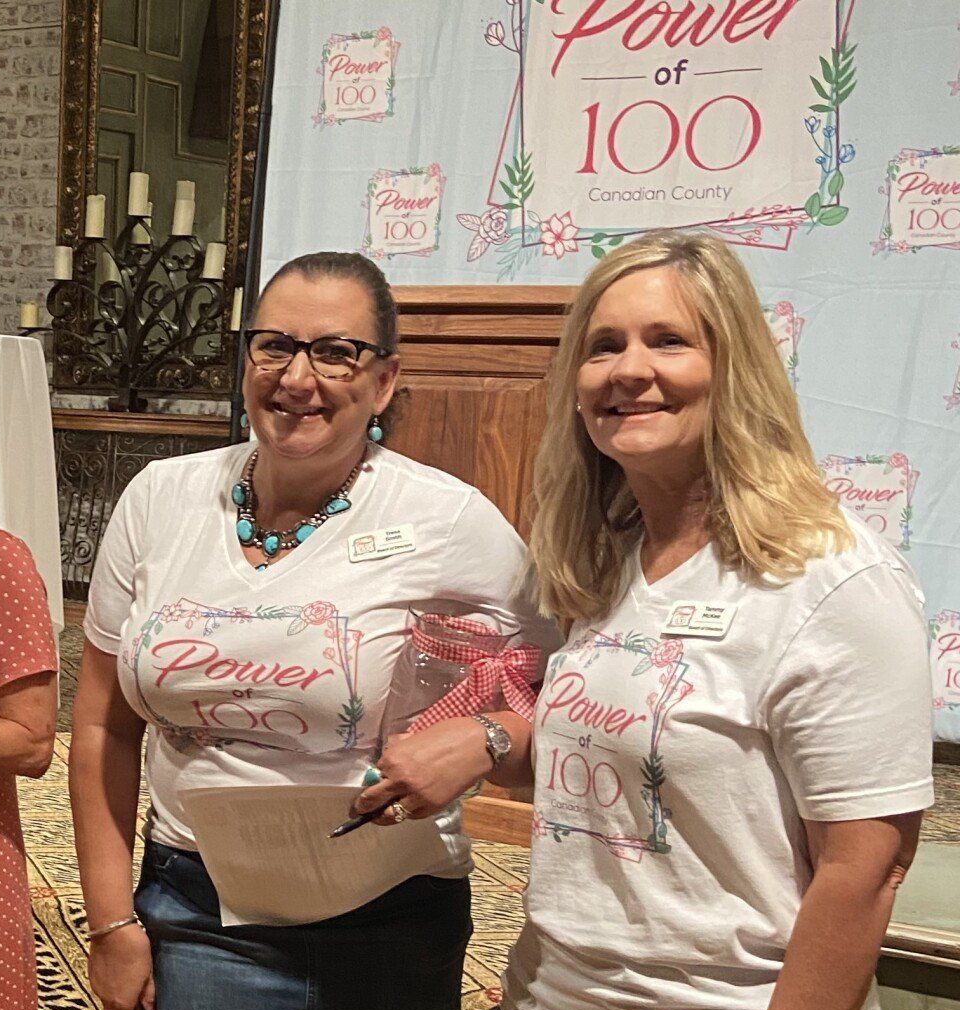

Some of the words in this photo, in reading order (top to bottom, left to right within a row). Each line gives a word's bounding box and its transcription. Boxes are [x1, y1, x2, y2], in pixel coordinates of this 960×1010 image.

[550, 0, 796, 78] Power
[328, 53, 388, 81] Power
[654, 59, 689, 86] of
[336, 85, 376, 105] 100
[576, 94, 762, 175] 100
[588, 186, 666, 202] Canadian
[671, 184, 733, 200] County
[897, 171, 960, 203] Powe
[375, 189, 438, 216] Power
[401, 211, 411, 219] of
[931, 197, 943, 206] of
[384, 220, 427, 240] 100
[151, 639, 335, 691] Power
[232, 688, 254, 698] of
[541, 671, 647, 737] Power
[190, 700, 309, 736] 100
[578, 734, 593, 750] of
[546, 747, 622, 808] 100
